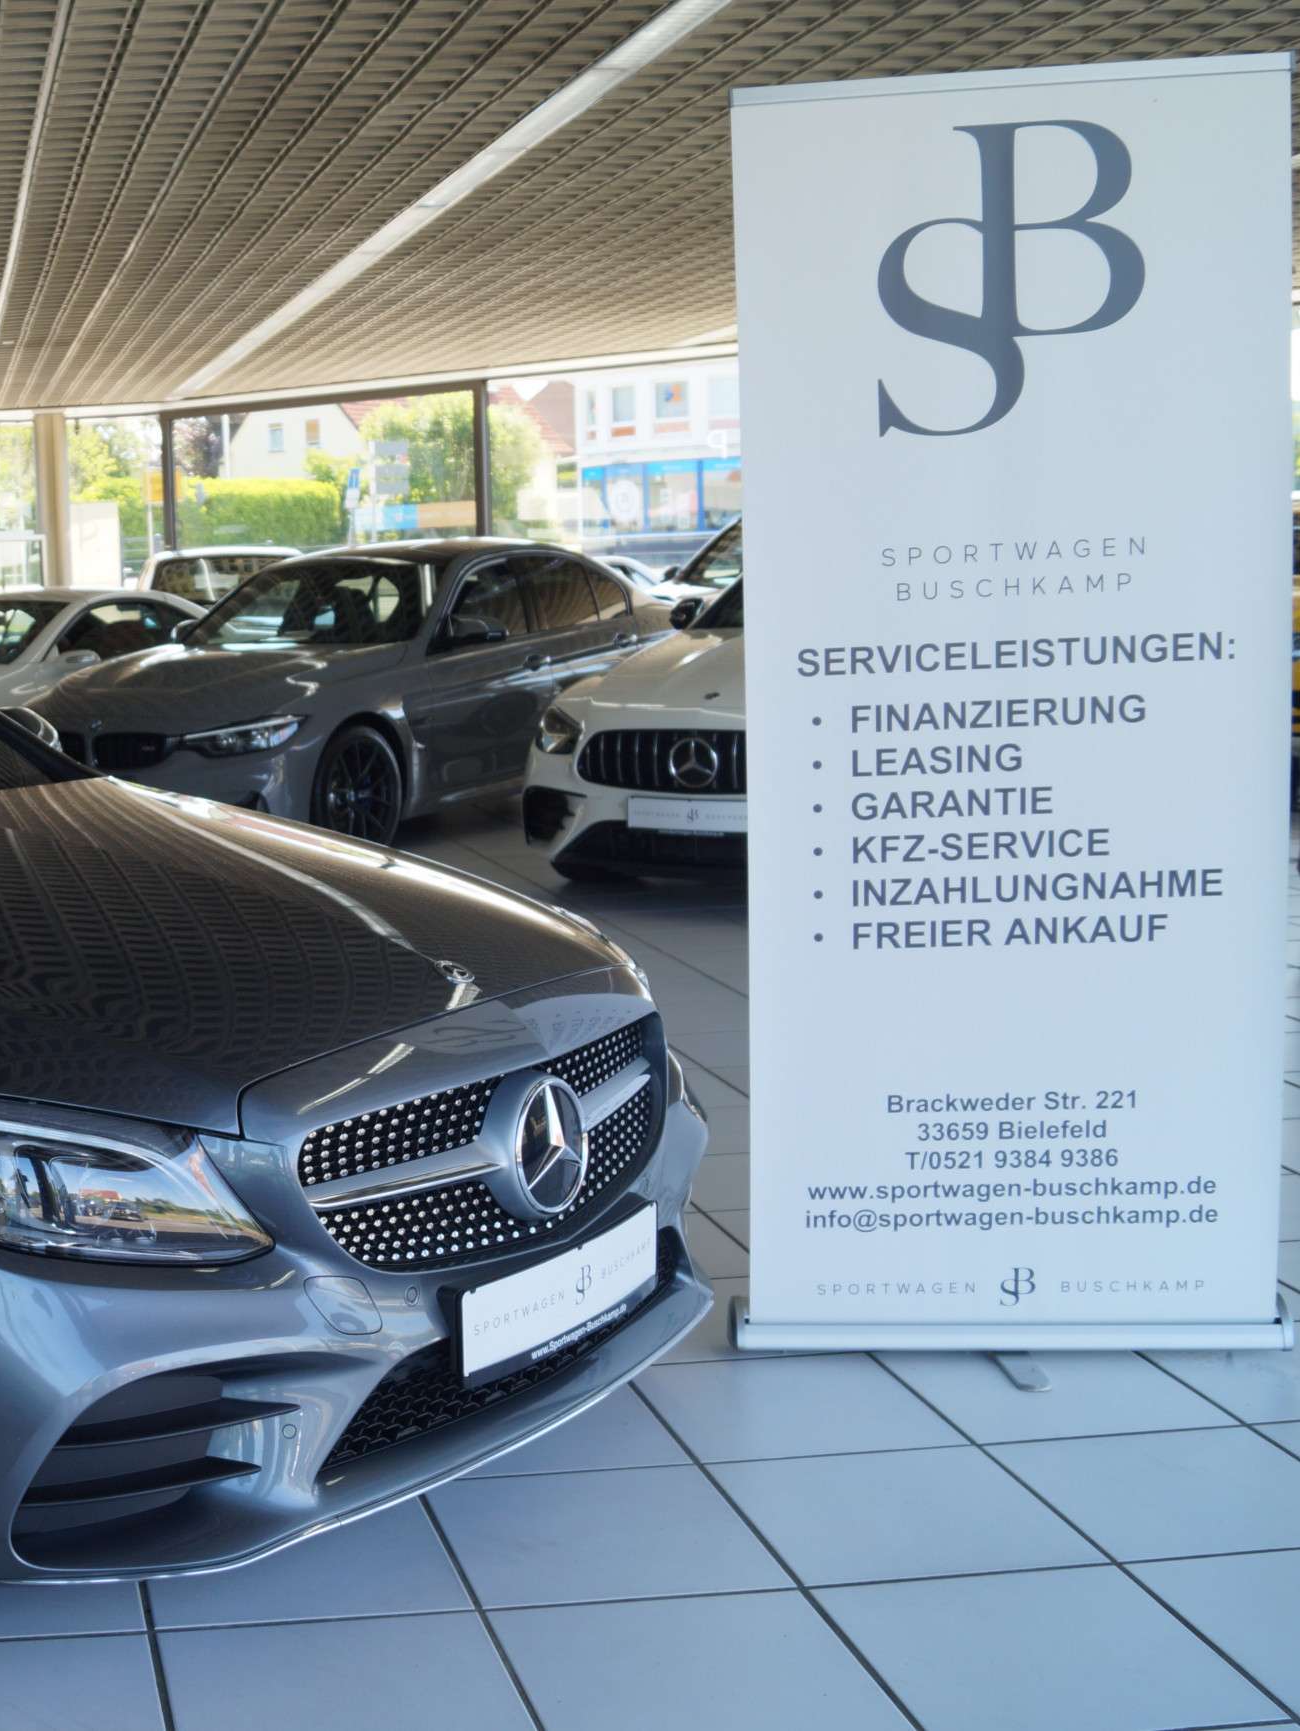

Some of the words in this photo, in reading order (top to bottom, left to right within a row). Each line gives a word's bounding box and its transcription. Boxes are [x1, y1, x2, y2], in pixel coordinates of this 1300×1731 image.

[881, 535, 1147, 568] SPORTWAGEN
[896, 572, 1133, 602] BUSCHKAMP
[797, 631, 1236, 677] SERVICELEISTUNGEN:
[851, 694, 1147, 734] FINANZIERUNG
[851, 743, 1024, 778] LEASING
[851, 785, 1054, 821] GARANTIE
[852, 827, 1111, 864] KFZ-SERVICE
[852, 868, 1224, 907] INZAHLUNGNAHME
[852, 918, 992, 950] FREIER
[1004, 913, 1169, 946] ANKAUF
[887, 1092, 1037, 1114] Brackweder
[1044, 1090, 1087, 1111] Str.
[1095, 1089, 1138, 1110] 221
[917, 1121, 989, 1142] 33659
[998, 1119, 1107, 1140] Bielefeld
[904, 1150, 984, 1171] T/0521
[994, 1149, 1053, 1169] 9384
[1060, 1148, 1119, 1168] 9386
[808, 1176, 1218, 1203] www.sportwagen-buschkamp.de
[805, 1204, 1219, 1233] info@sportwagen-buschkamp.de
[473, 1288, 566, 1337] SPORTWAGEN
[601, 1237, 652, 1279] BUSCHKAMP
[817, 1281, 977, 1296] SPORTWAGEN
[1060, 1279, 1206, 1293] BUSCHKAMP
